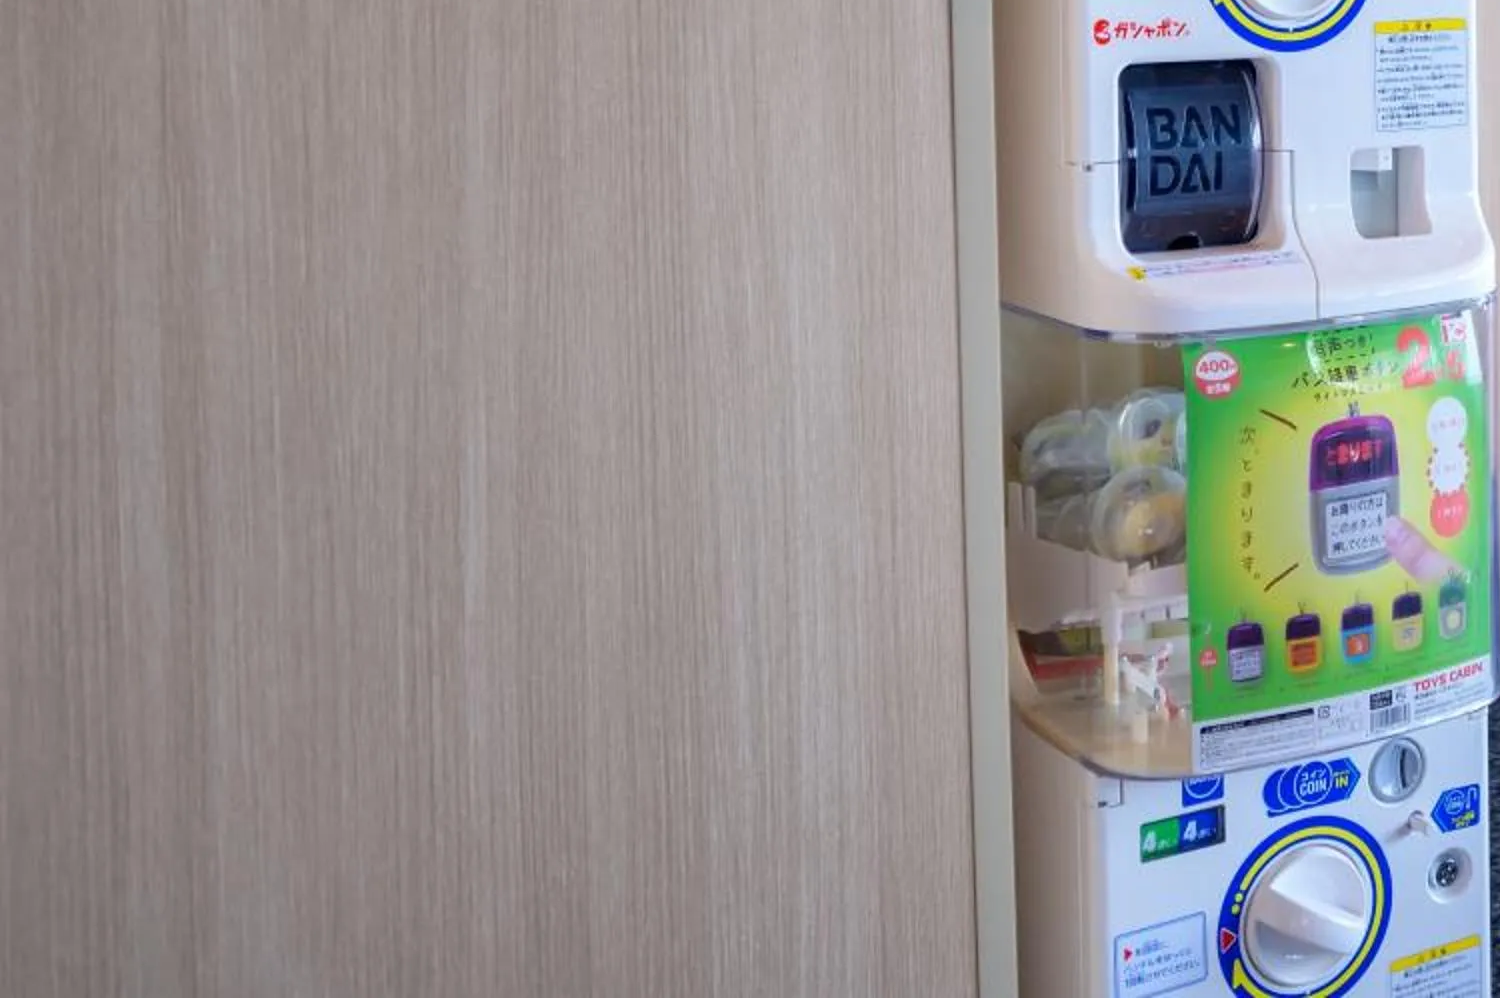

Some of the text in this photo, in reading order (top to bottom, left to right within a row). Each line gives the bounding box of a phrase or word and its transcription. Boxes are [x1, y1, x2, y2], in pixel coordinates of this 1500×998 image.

[1114, 18, 1187, 39] ガシャポン
[1146, 103, 1242, 151] BAN
[1150, 151, 1223, 197] DAI
[1414, 677, 1447, 693] TOYS
[1449, 662, 1484, 681] CABIN
[1300, 775, 1349, 797] COIN IN
